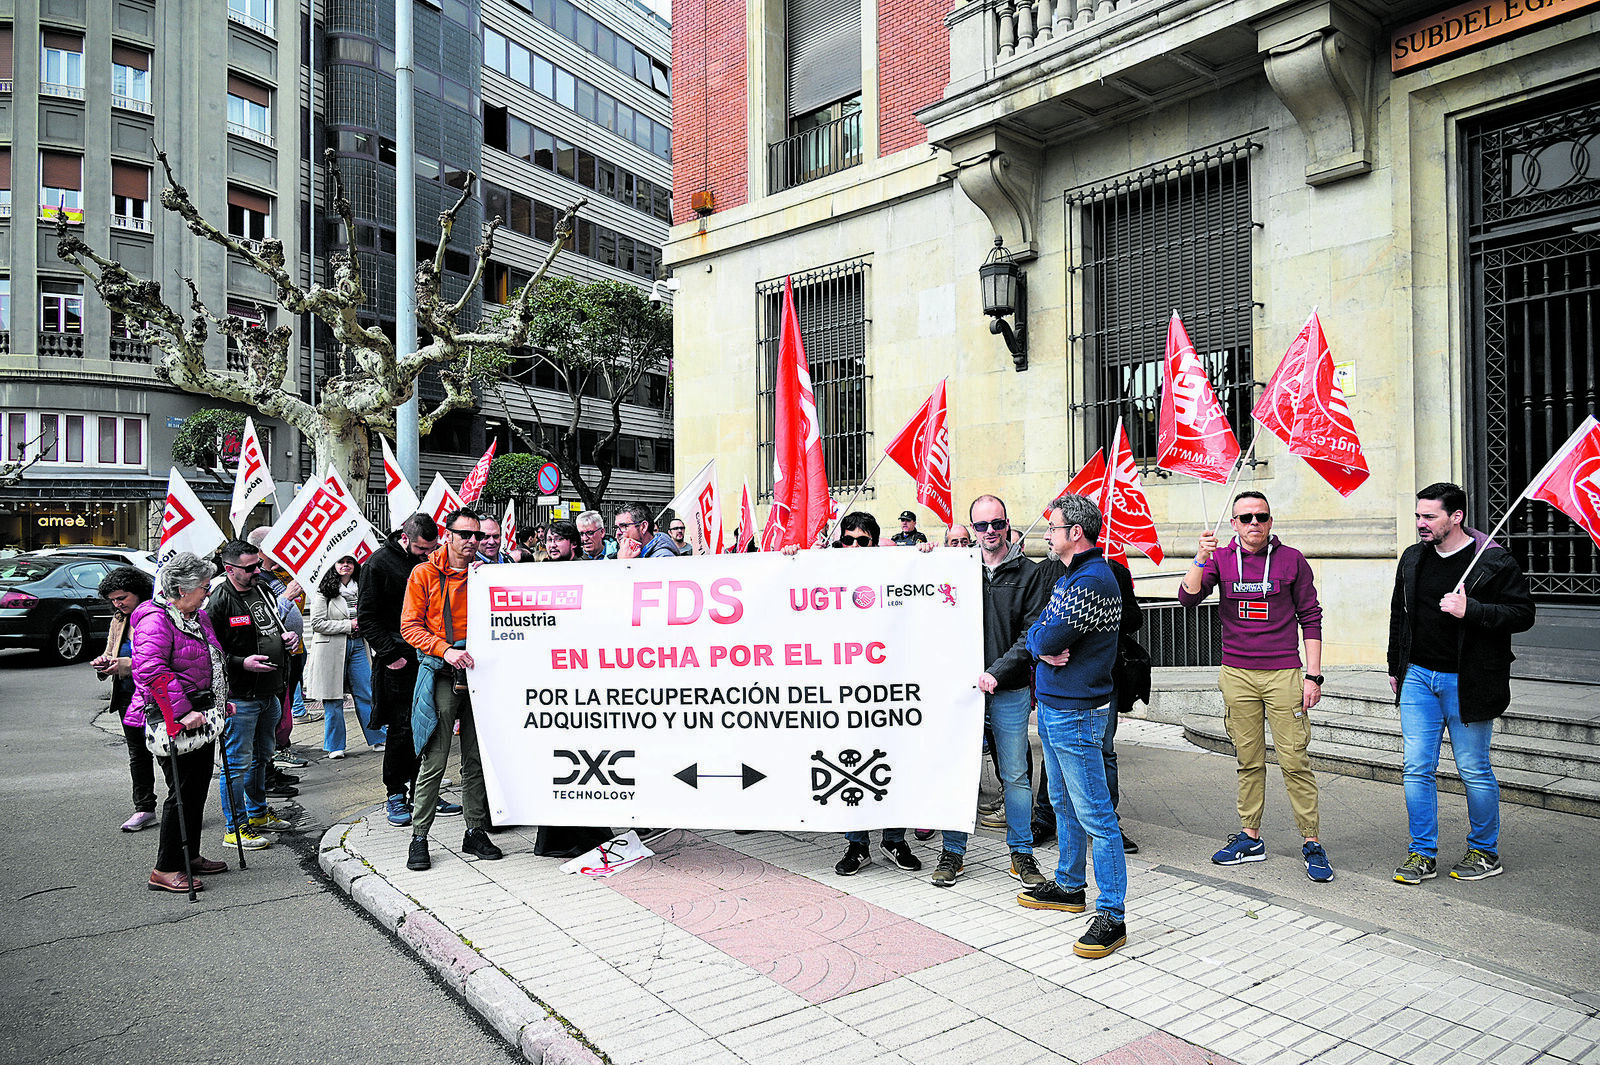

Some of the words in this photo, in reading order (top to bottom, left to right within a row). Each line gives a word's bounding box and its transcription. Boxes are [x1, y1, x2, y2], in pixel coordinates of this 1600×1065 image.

[790, 587, 847, 611] UGT
[887, 584, 935, 597] FeSMC
[632, 577, 744, 627] FDS
[490, 612, 556, 627] industria
[491, 629, 525, 641] León
[551, 649, 588, 669] EN
[599, 647, 700, 669] LUCHA
[710, 645, 774, 667] POR
[785, 643, 822, 666] EL
[834, 642, 887, 664] IPC
[526, 689, 568, 705] POR
[575, 688, 601, 705] LA
[607, 682, 780, 705] RECUPERACIÓN
[788, 686, 832, 704] DEL
[840, 683, 922, 704] PODER
[524, 712, 657, 730] ADQUISITIVO
[663, 711, 677, 729] Y
[684, 711, 713, 729] UN
[721, 711, 839, 729] CONVENIO
[848, 708, 922, 729] DIGNO
[553, 790, 636, 800] TECHNOLOGY
